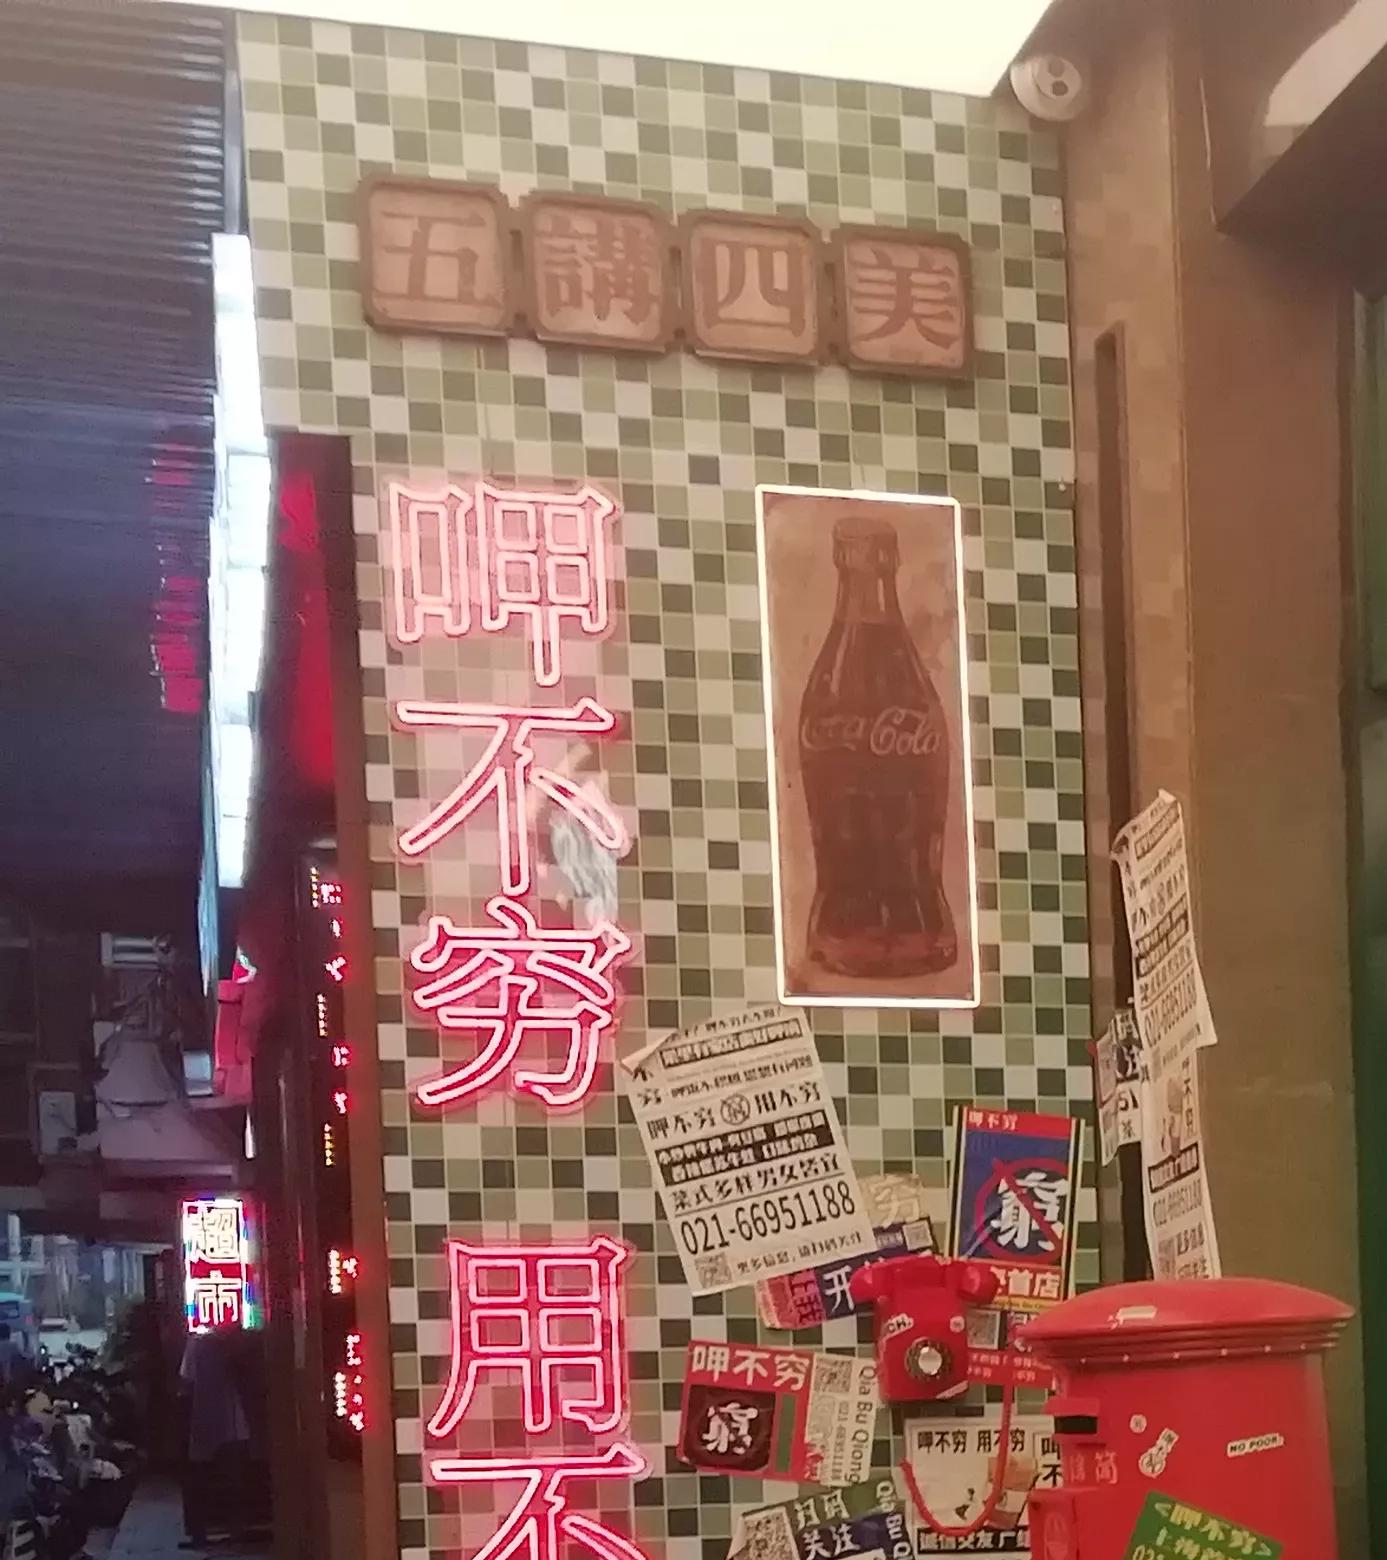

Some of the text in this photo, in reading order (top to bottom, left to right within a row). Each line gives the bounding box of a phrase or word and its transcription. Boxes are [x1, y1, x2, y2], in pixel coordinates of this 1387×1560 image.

[378, 207, 967, 350] 五講四美
[386, 482, 634, 1106] 呷不穷
[680, 1180, 857, 1257] 021-66951188
[691, 1345, 811, 1392] 呷不穷
[917, 1429, 968, 1455] 呷不穷
